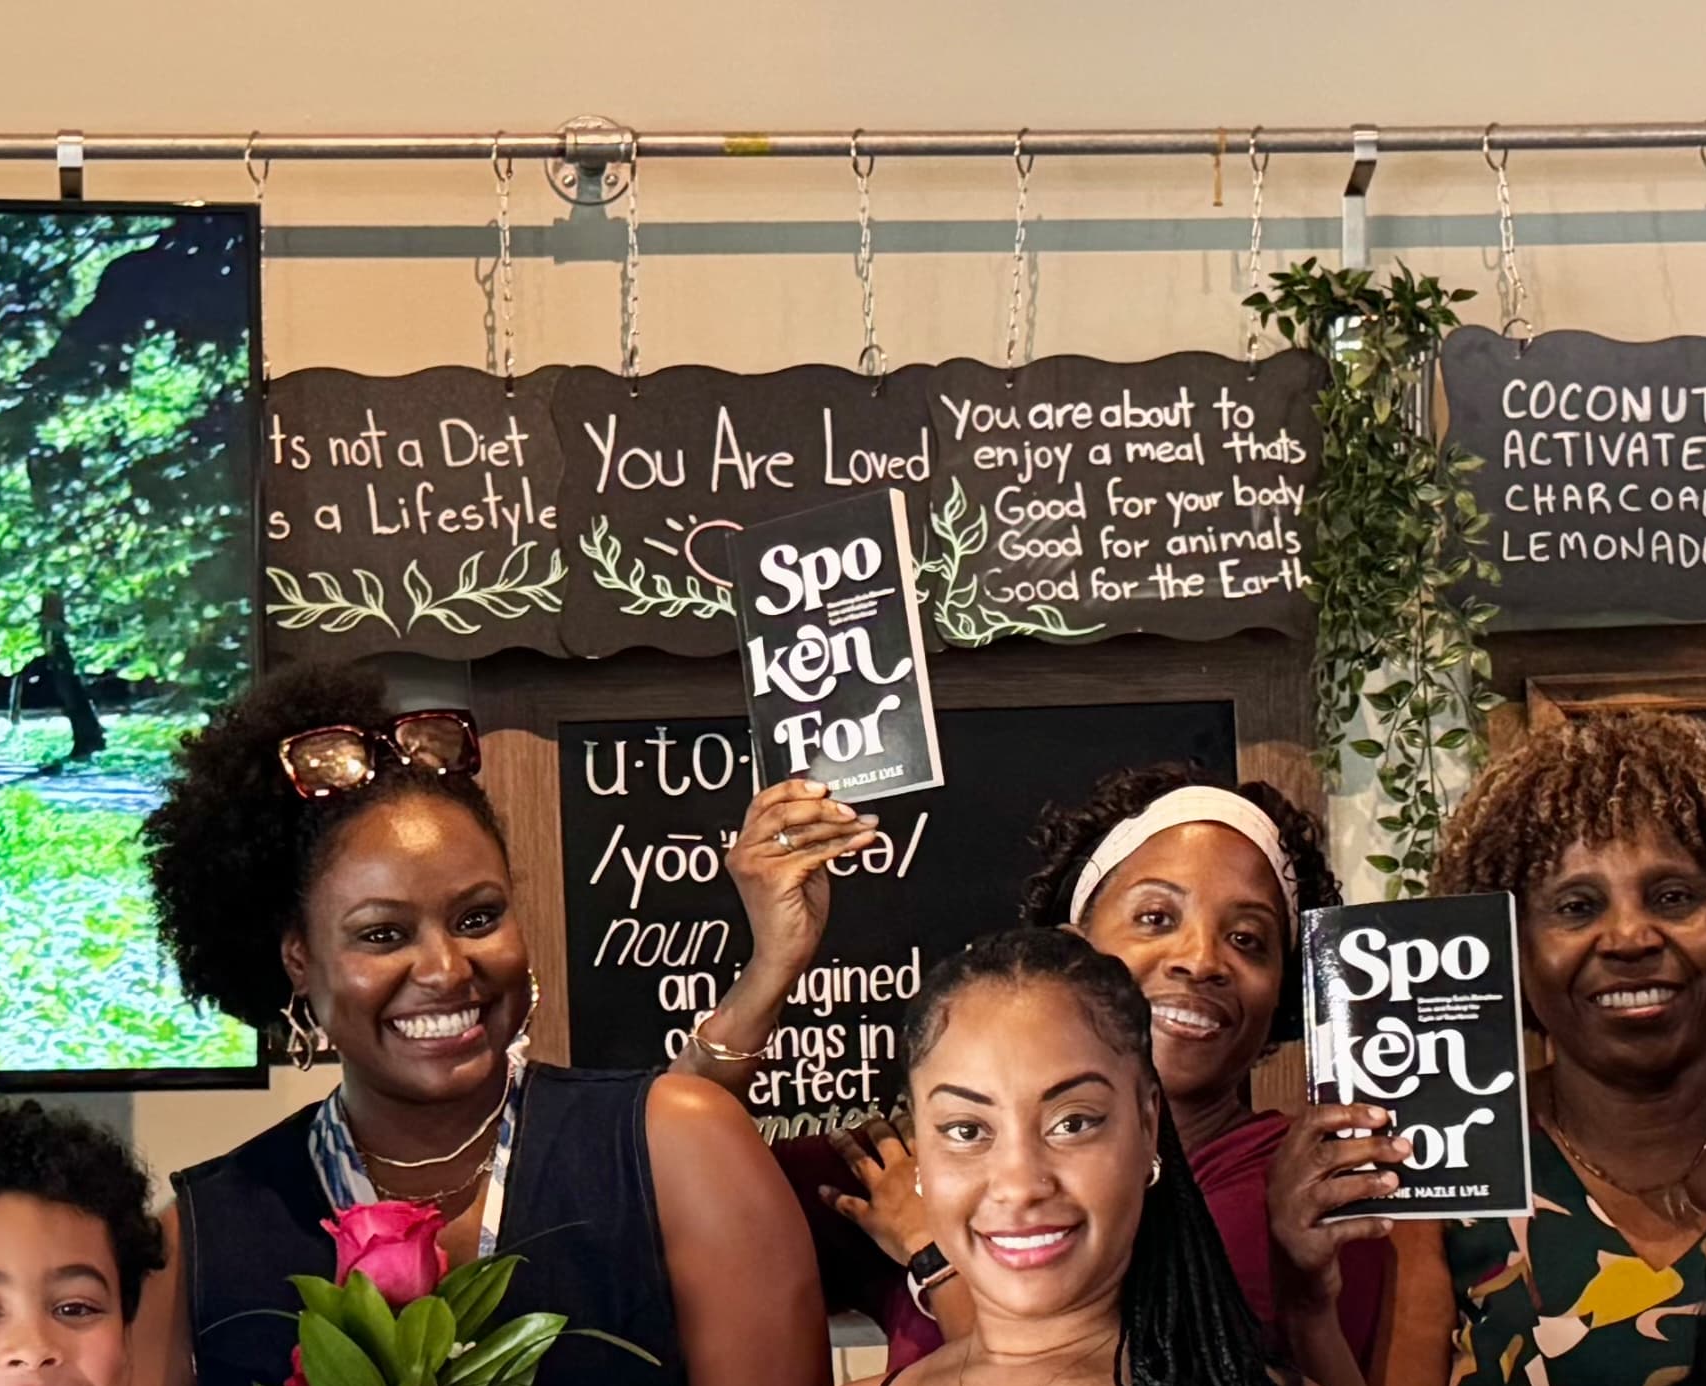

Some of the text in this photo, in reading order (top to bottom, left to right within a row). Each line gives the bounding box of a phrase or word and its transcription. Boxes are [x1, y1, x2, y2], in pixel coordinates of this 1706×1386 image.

[1028, 402, 1093, 431] are
[1100, 388, 1194, 429] about
[1213, 387, 1255, 431] to
[329, 409, 387, 469] not
[398, 435, 423, 468] a
[440, 416, 529, 469] Diet
[584, 406, 931, 493] You Are Loved
[973, 428, 1307, 484] enjoy a meal thats
[314, 505, 341, 534] a
[367, 472, 557, 547] Lifestyle
[995, 475, 1305, 528] Good for your body
[998, 517, 1302, 561] Good for animals
[755, 537, 882, 616] Spo
[983, 557, 1313, 604] Good for the Earth
[747, 624, 912, 702] ken
[773, 694, 901, 774] For
[595, 918, 729, 968] noun
[1329, 928, 1490, 1002] Spo
[658, 972, 717, 1011] an
[860, 1015, 895, 1060] in
[1316, 1017, 1515, 1100] ken
